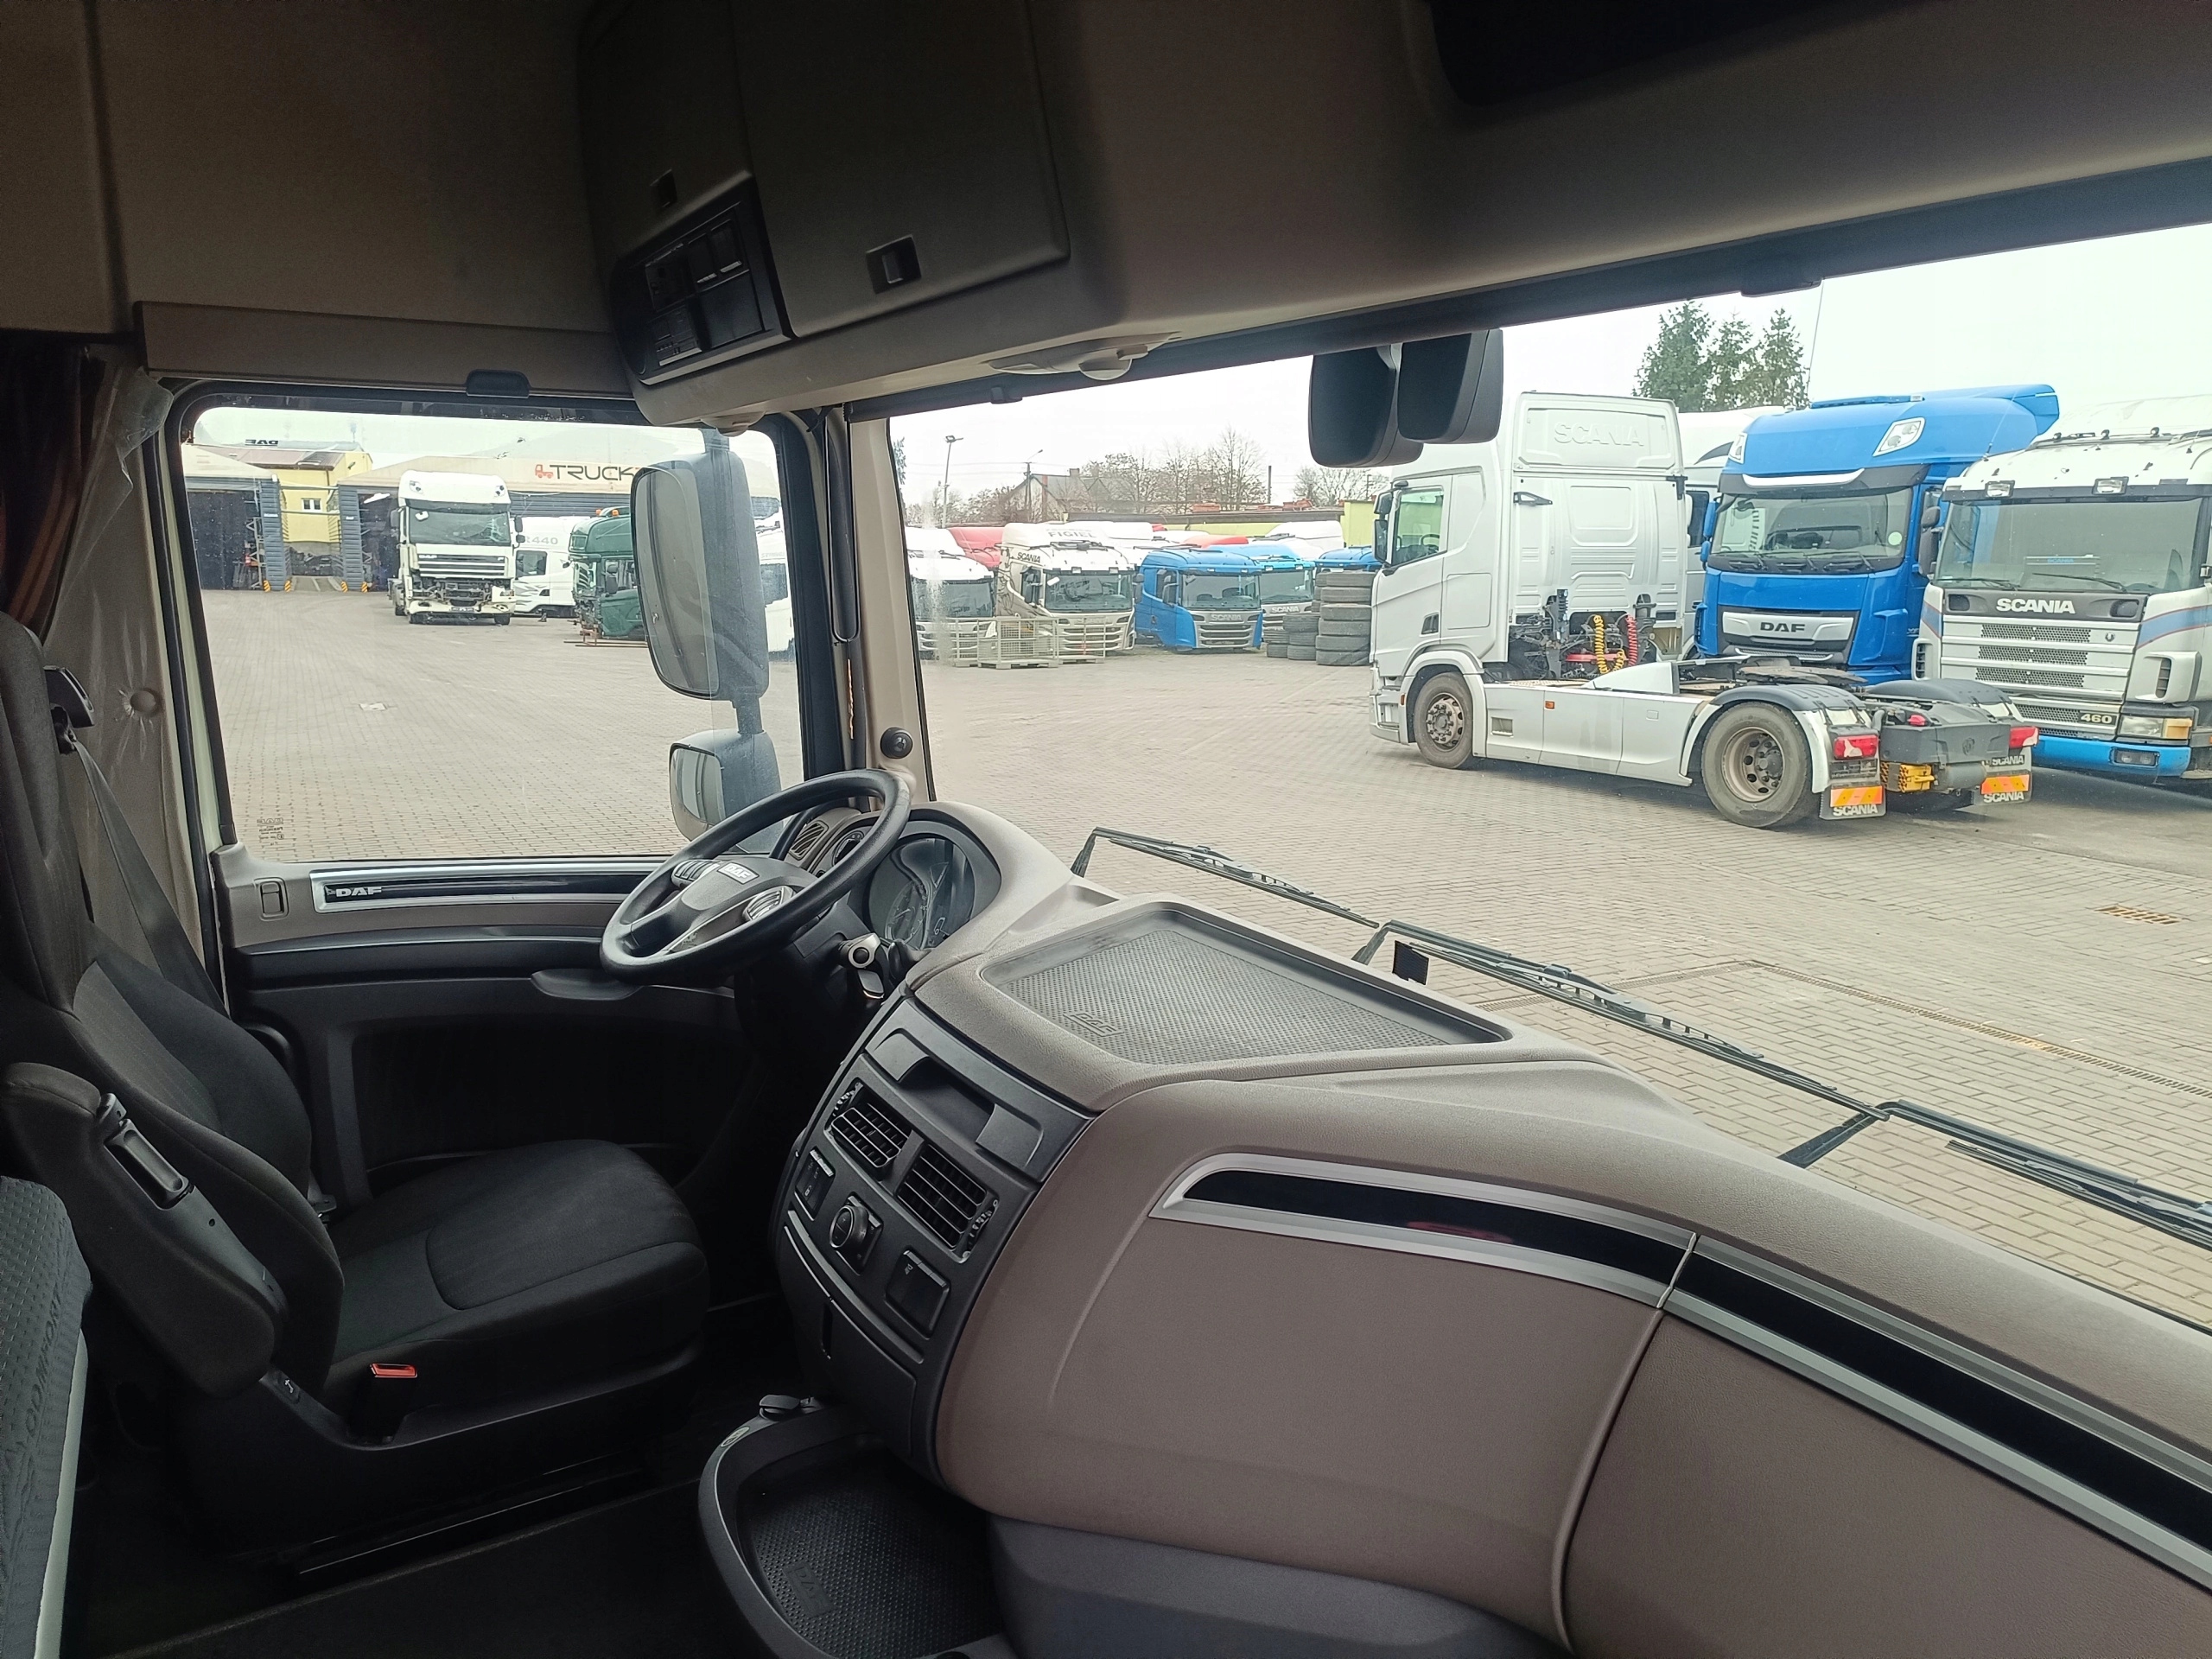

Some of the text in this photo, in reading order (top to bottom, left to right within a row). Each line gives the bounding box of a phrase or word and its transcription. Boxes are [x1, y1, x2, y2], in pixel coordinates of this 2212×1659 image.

[1554, 423, 1644, 447] SCANIA
[1017, 551, 1041, 563] SCANIA
[1996, 598, 2075, 614] SCANIA
[1759, 621, 1806, 632] DAF
[2081, 714, 2113, 724] 460
[1992, 755, 2024, 766] SCANIA
[1983, 791, 2024, 804] SCANIA
[1833, 804, 1878, 817] SCANIA
[724, 864, 752, 879] DAF
[335, 887, 382, 898] DAF
[1071, 1012, 1118, 1034] DAF
